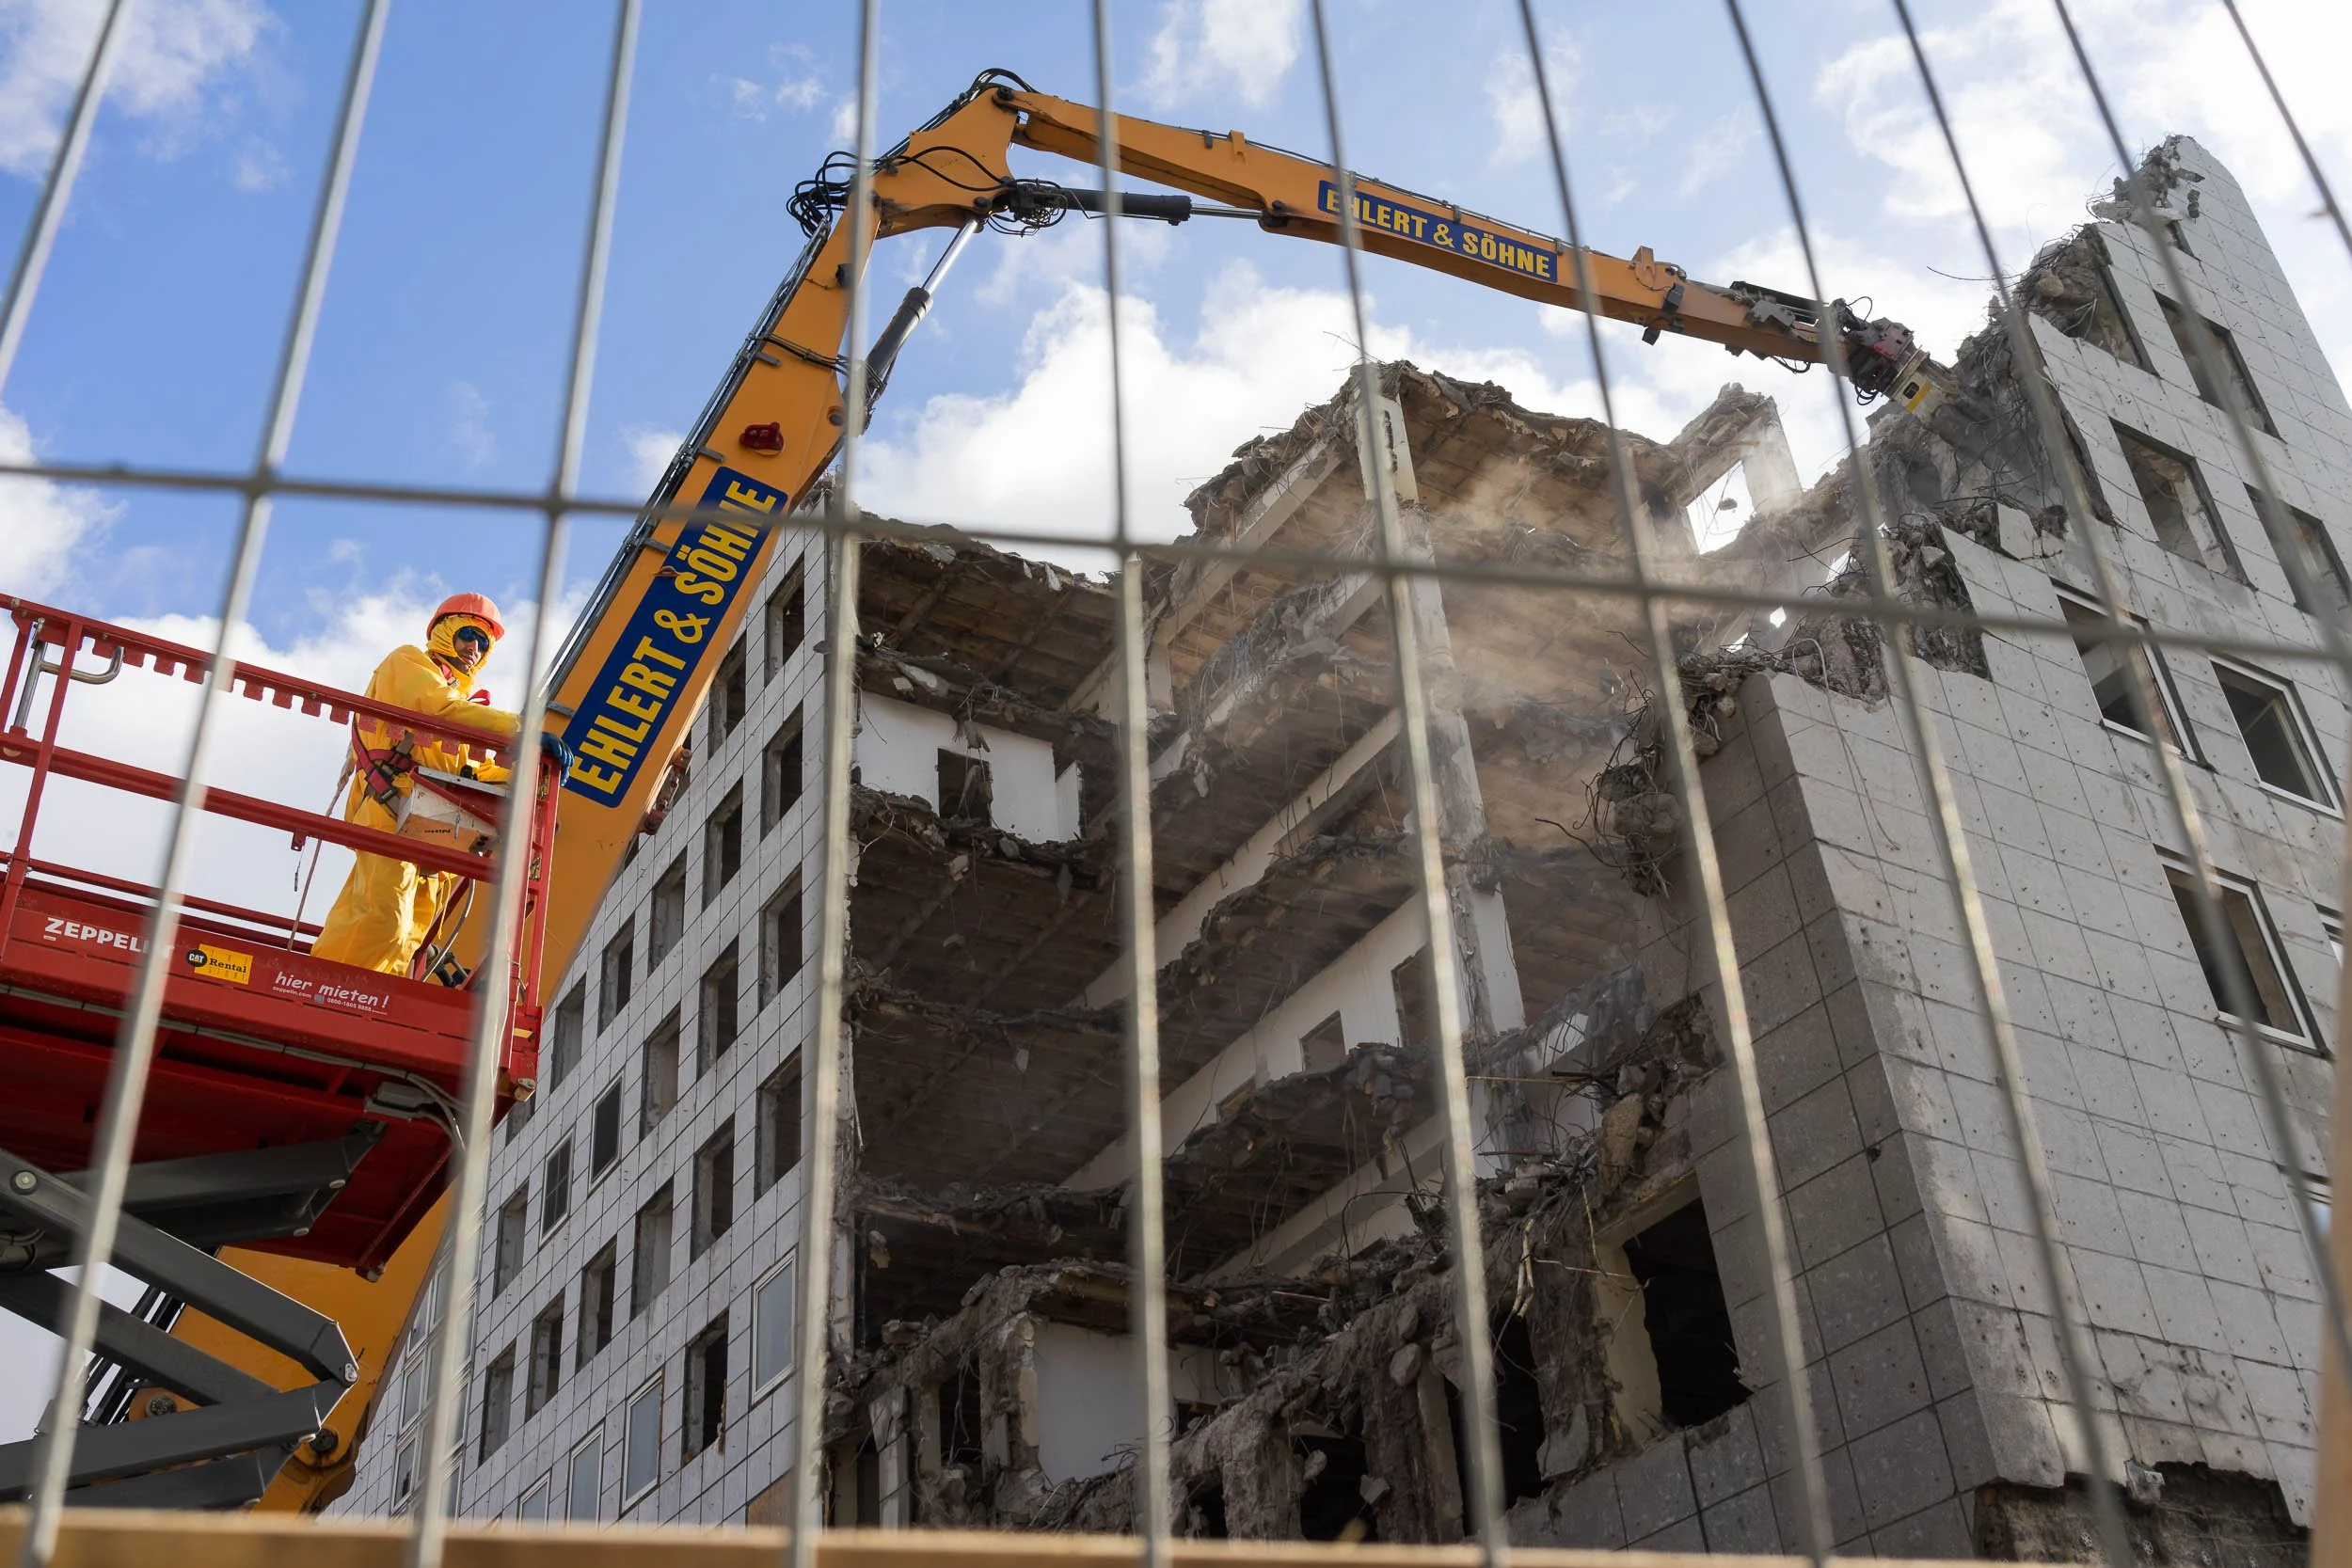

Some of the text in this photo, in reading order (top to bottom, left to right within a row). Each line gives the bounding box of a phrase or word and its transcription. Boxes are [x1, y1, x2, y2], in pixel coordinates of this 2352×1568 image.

[1327, 188, 1550, 278] EHLERT & SÖHNE
[570, 636, 686, 795] EHLERT
[654, 609, 711, 644] &
[188, 953, 204, 964] CAT
[209, 958, 246, 974] Rental
[275, 971, 312, 990] hier
[319, 984, 378, 1006] mieten
